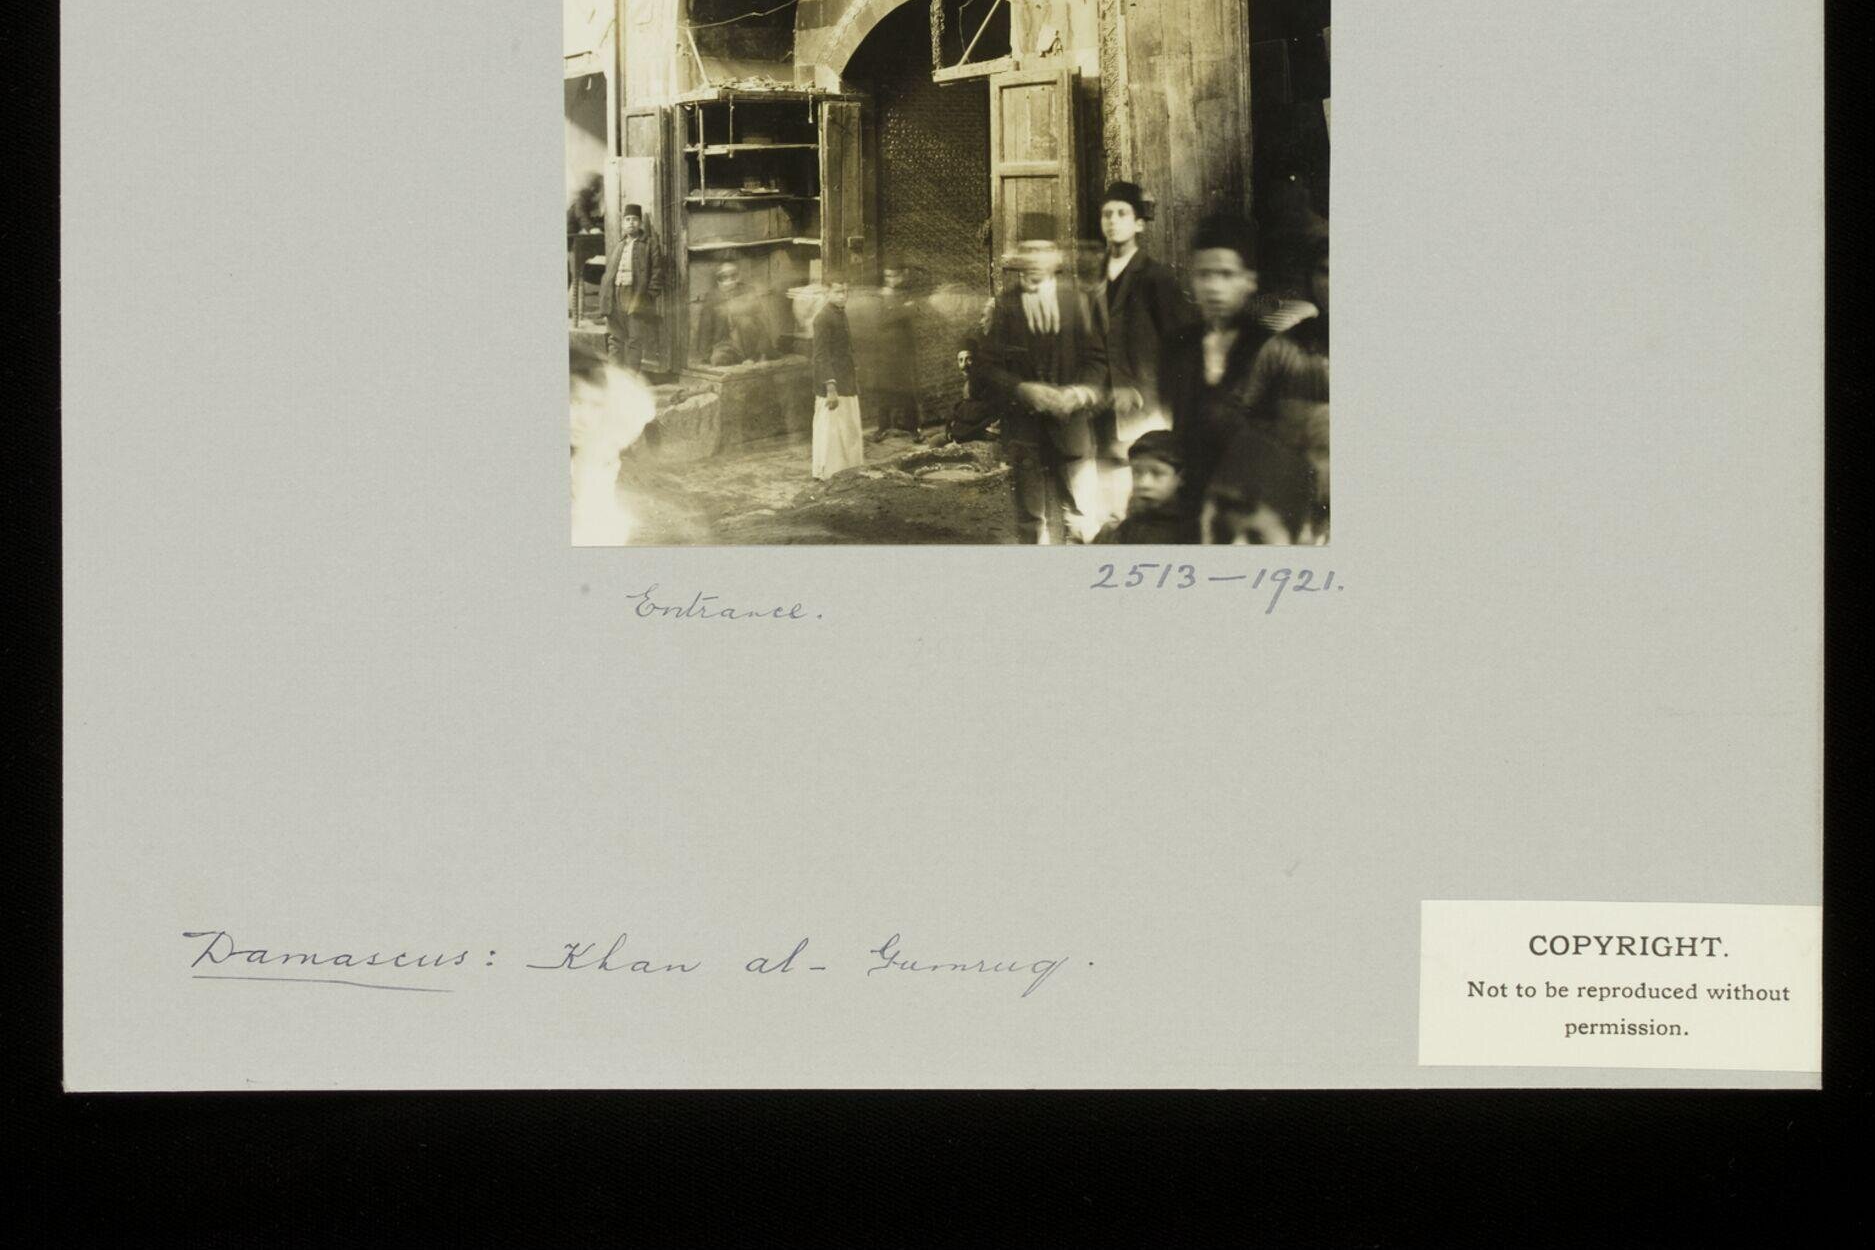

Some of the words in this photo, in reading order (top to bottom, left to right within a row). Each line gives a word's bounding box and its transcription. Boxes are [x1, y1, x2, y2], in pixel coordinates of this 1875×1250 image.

[626, 582, 823, 620] Entrance.
[526, 933, 702, 974] Khan
[1529, 934, 1729, 958] COPYRIGHT.
[1467, 981, 1509, 999] Not
[1515, 982, 1538, 999] to
[1545, 981, 1570, 999] be
[1577, 982, 1699, 1003] reproduced
[1706, 983, 1792, 1002] without
[1565, 1018, 1689, 1039] permission.
